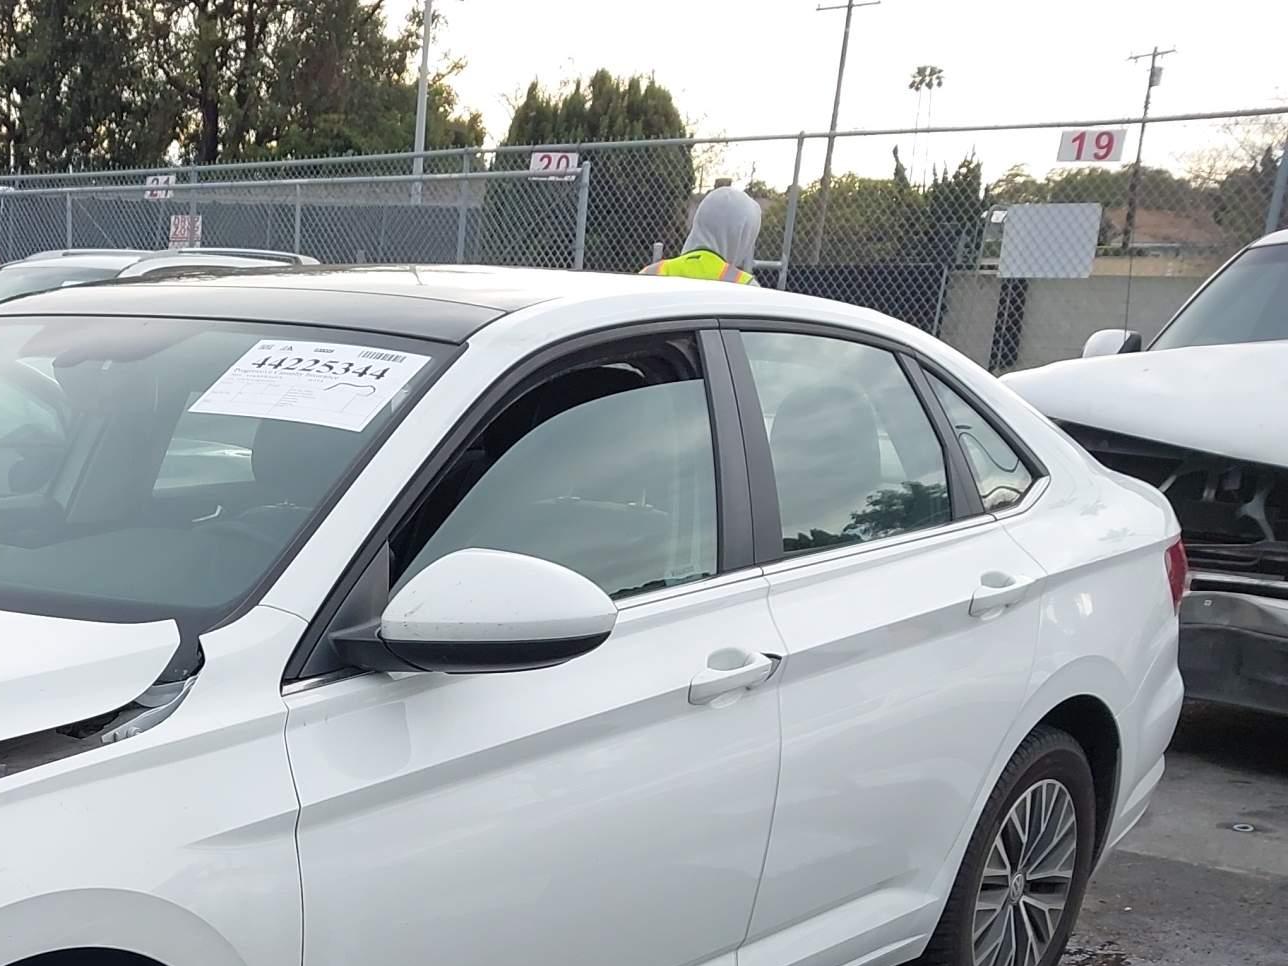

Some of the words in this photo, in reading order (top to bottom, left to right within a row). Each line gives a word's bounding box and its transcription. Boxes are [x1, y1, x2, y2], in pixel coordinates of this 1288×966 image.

[1071, 131, 1114, 161] 19
[539, 153, 570, 170] 20
[252, 356, 391, 380] 44225344
